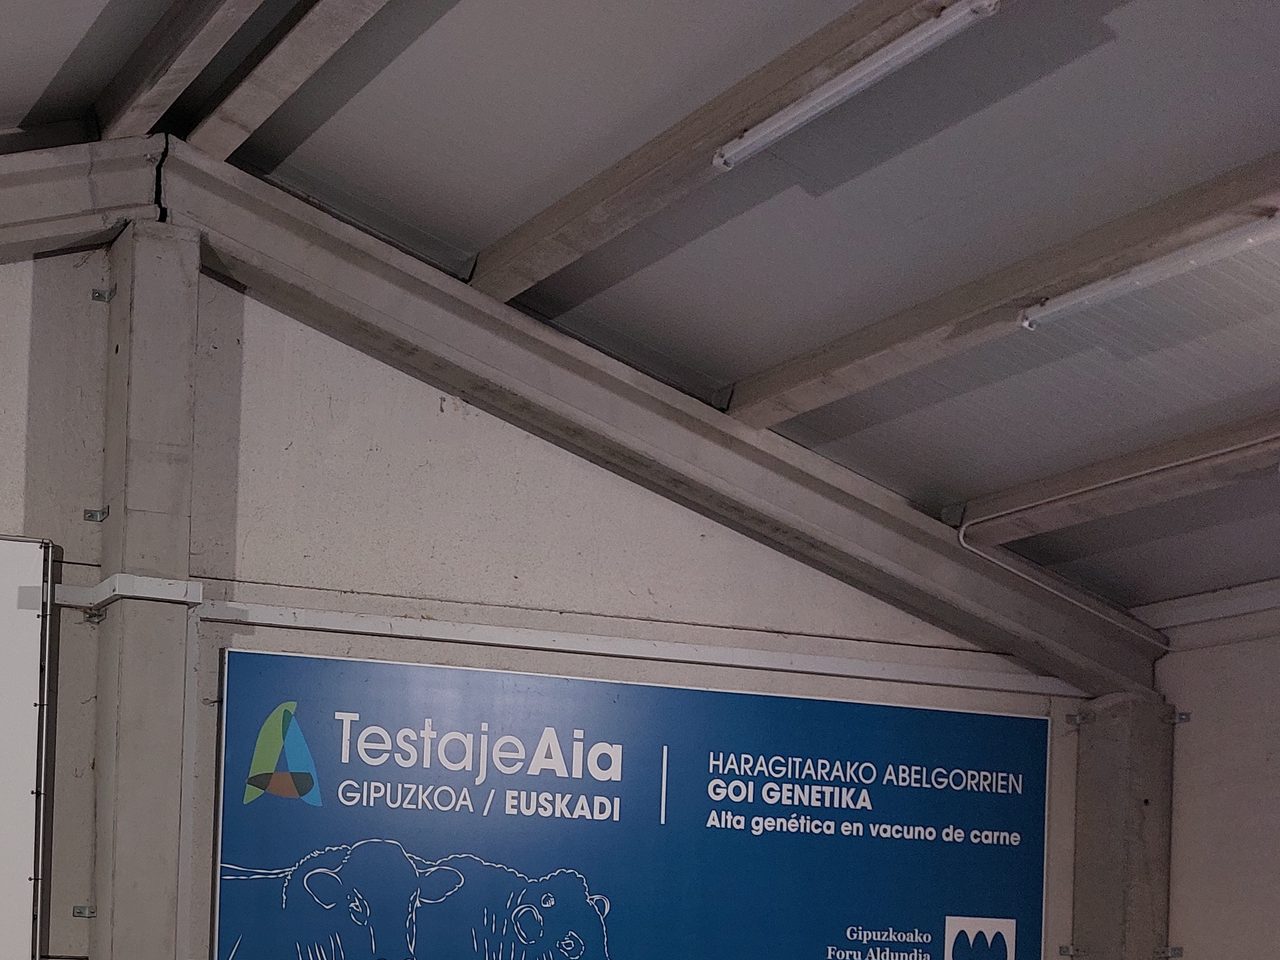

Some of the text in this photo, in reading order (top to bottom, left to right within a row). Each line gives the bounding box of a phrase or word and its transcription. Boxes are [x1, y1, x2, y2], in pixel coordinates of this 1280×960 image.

[334, 711, 623, 786] TestajeAia
[708, 751, 1023, 795] HARAGITARAKO ABELGORRIEN
[337, 779, 474, 813] GIPUZKOA
[504, 790, 620, 822] EUSKADI
[707, 779, 873, 810] GOI GENETIKA
[706, 809, 1021, 846] Alta genética en vacuno de carne
[827, 946, 862, 960] Foru
[846, 927, 932, 944] Gipuzkoako
